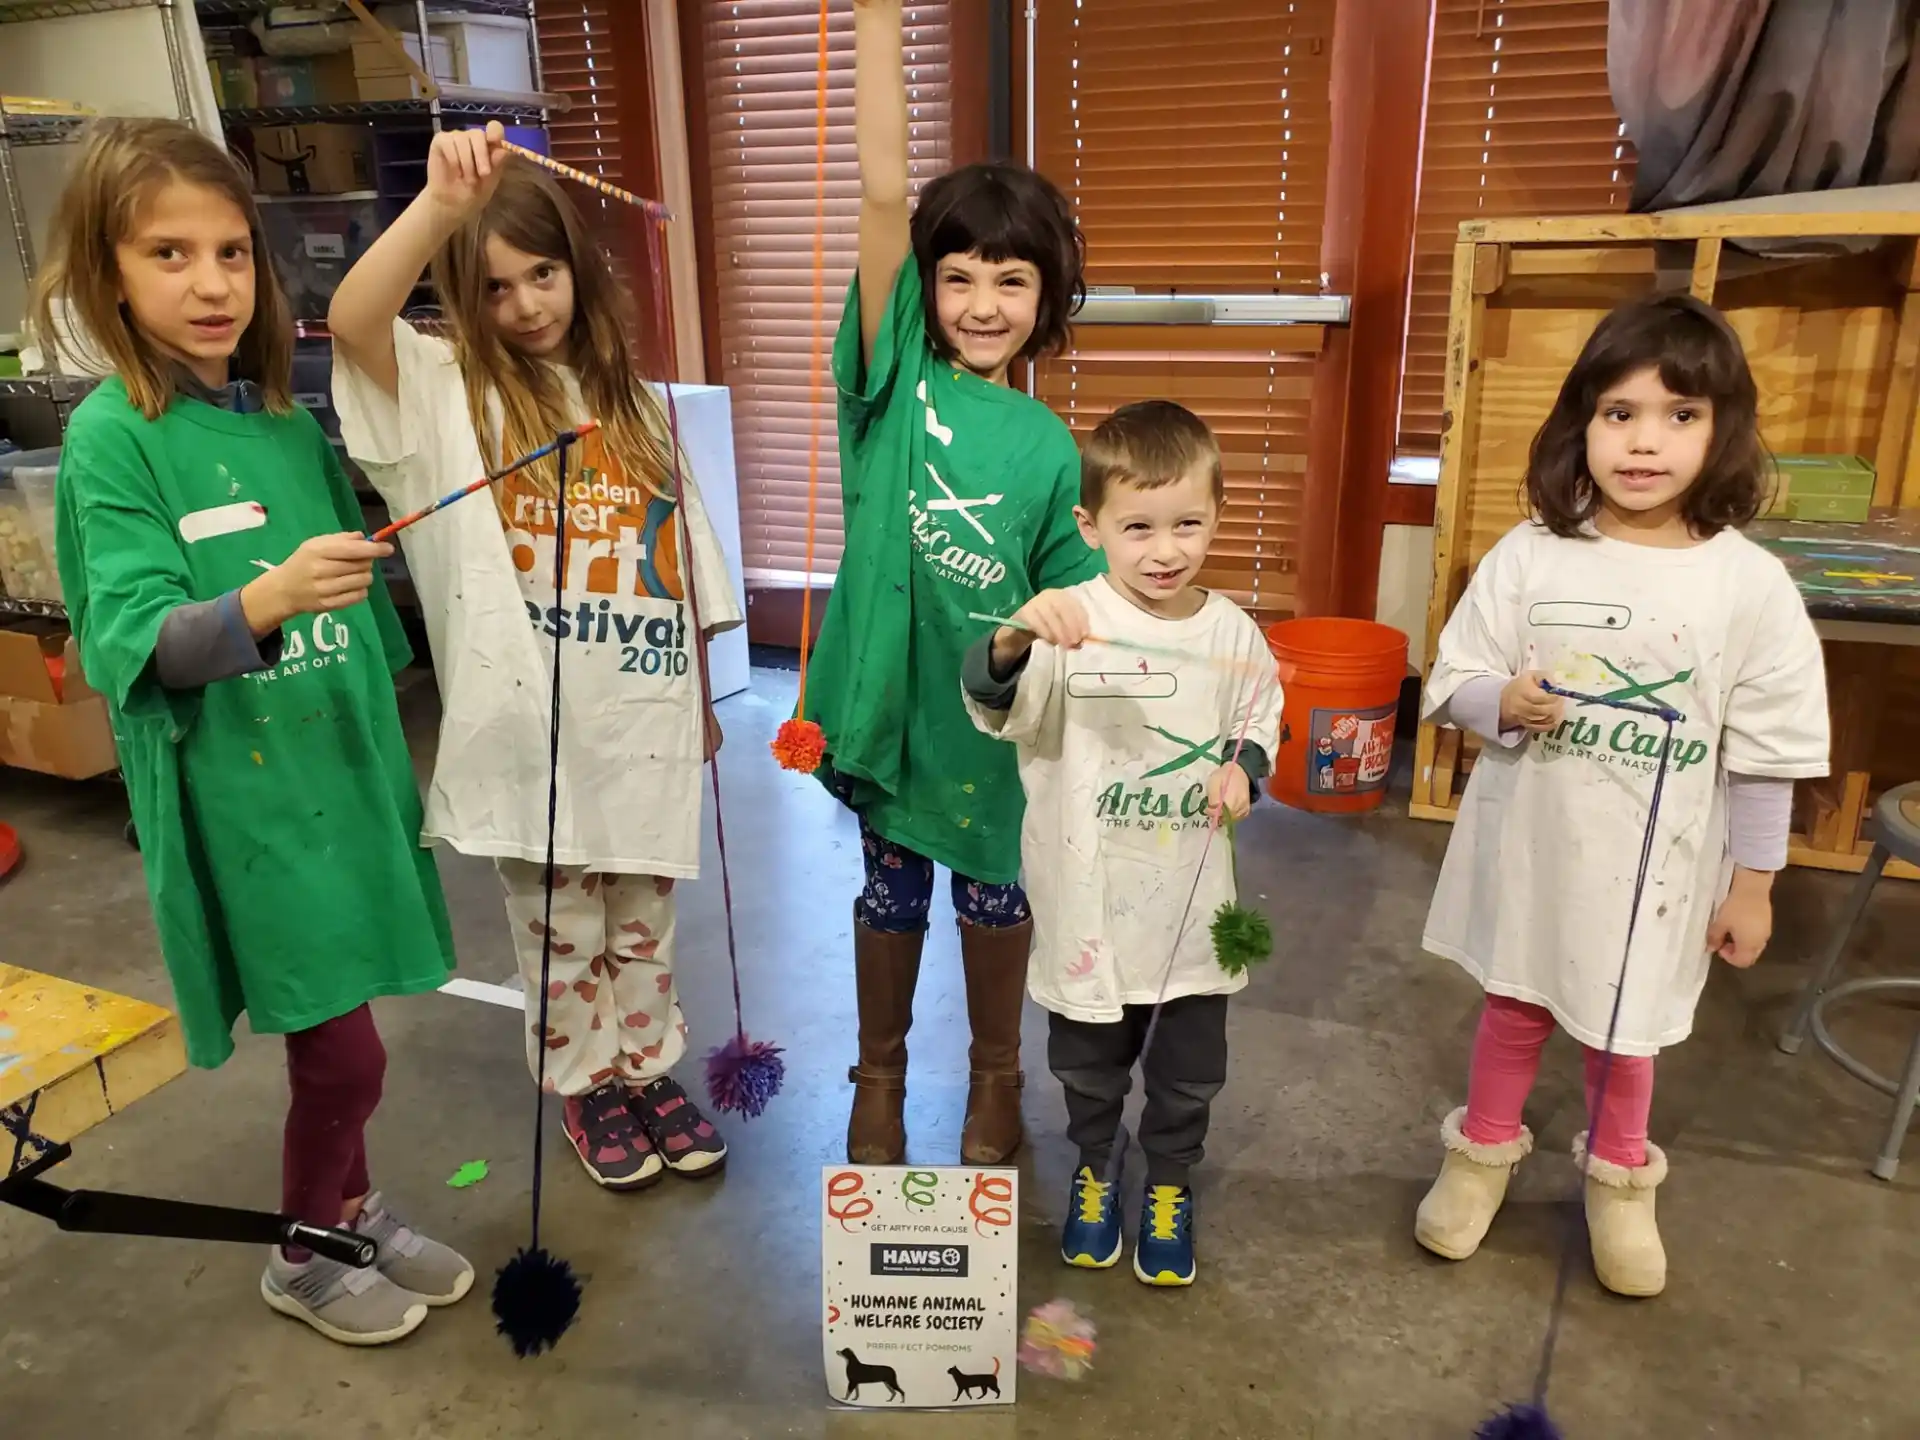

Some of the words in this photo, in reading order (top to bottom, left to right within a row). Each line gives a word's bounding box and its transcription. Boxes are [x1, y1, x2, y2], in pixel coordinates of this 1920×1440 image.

[514, 493, 617, 532] river
[505, 526, 648, 597] art
[929, 530, 1006, 590] Camp
[525, 598, 686, 650] estival
[283, 661, 308, 677] ART
[312, 656, 331, 669] OF
[617, 645, 689, 677] 2010
[1543, 741, 1562, 754] THE
[1566, 749, 1593, 761] ART
[1598, 753, 1616, 763] OF
[1609, 720, 1708, 772] Camp
[1096, 782, 1169, 818] Arts
[1106, 818, 1131, 828] THE
[1170, 822, 1188, 832] OF
[870, 1224, 888, 1232] GET
[889, 1225, 912, 1233] ARTY
[914, 1225, 931, 1233] FOR
[940, 1225, 969, 1234] CAUSE
[882, 1249, 941, 1265] HAWS
[851, 1294, 918, 1310] HUMANE
[922, 1296, 986, 1312] ANIMAL
[854, 1313, 922, 1329] WELFARE
[925, 1314, 984, 1331] SOCIETY
